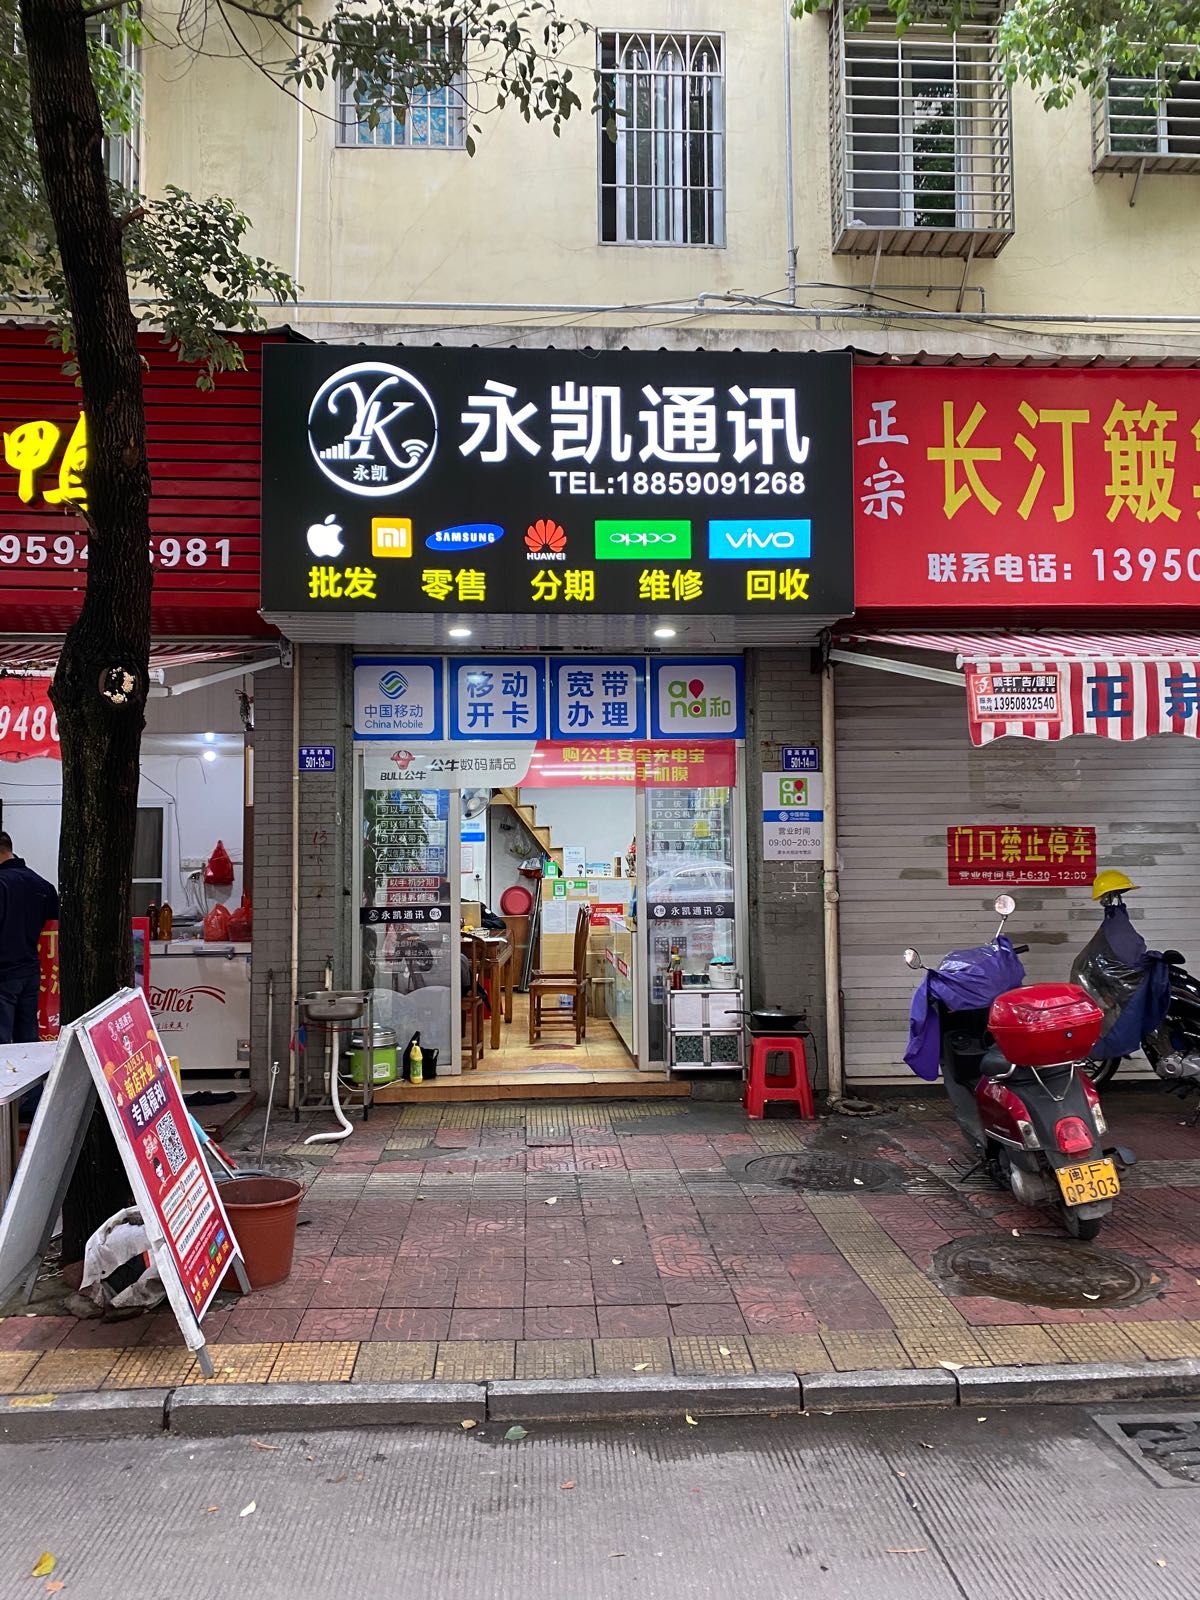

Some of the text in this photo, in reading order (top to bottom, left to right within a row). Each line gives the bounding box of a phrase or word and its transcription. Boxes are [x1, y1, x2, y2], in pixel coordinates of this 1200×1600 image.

[457, 379, 811, 466] 永凯通讯
[857, 400, 909, 520] 正宗
[927, 398, 1200, 524] 长汀簸
[353, 465, 388, 482] 永凯
[549, 471, 805, 496] TEL:18859091268
[435, 531, 496, 544] SAMSUNG
[526, 552, 567, 562] HUAWEI
[308, 565, 811, 602] 批发 零售 分期 维修 回收
[466, 671, 529, 699] 移动
[567, 670, 629, 698] 宽带
[364, 704, 424, 719] 中国移动
[710, 698, 731, 718] 和
[994, 696, 1055, 711] 13950832540
[364, 719, 424, 729] China Mobile
[466, 702, 530, 729] 开卡
[567, 702, 629, 728] 办理
[430, 757, 517, 771] 公牛数码精品
[562, 747, 705, 763] 购公牛安全充电宝
[768, 838, 821, 847] 09:00-20:30
[778, 827, 811, 836] 营业时间
[955, 827, 1092, 863] 门口禁止停车
[381, 910, 425, 920] 永凯通讯
[671, 906, 713, 916] 永凯通讯
[123, 1061, 156, 1100] 新店开业
[131, 1080, 167, 1126] 专属福利
[1066, 1177, 1118, 1203] QP303
